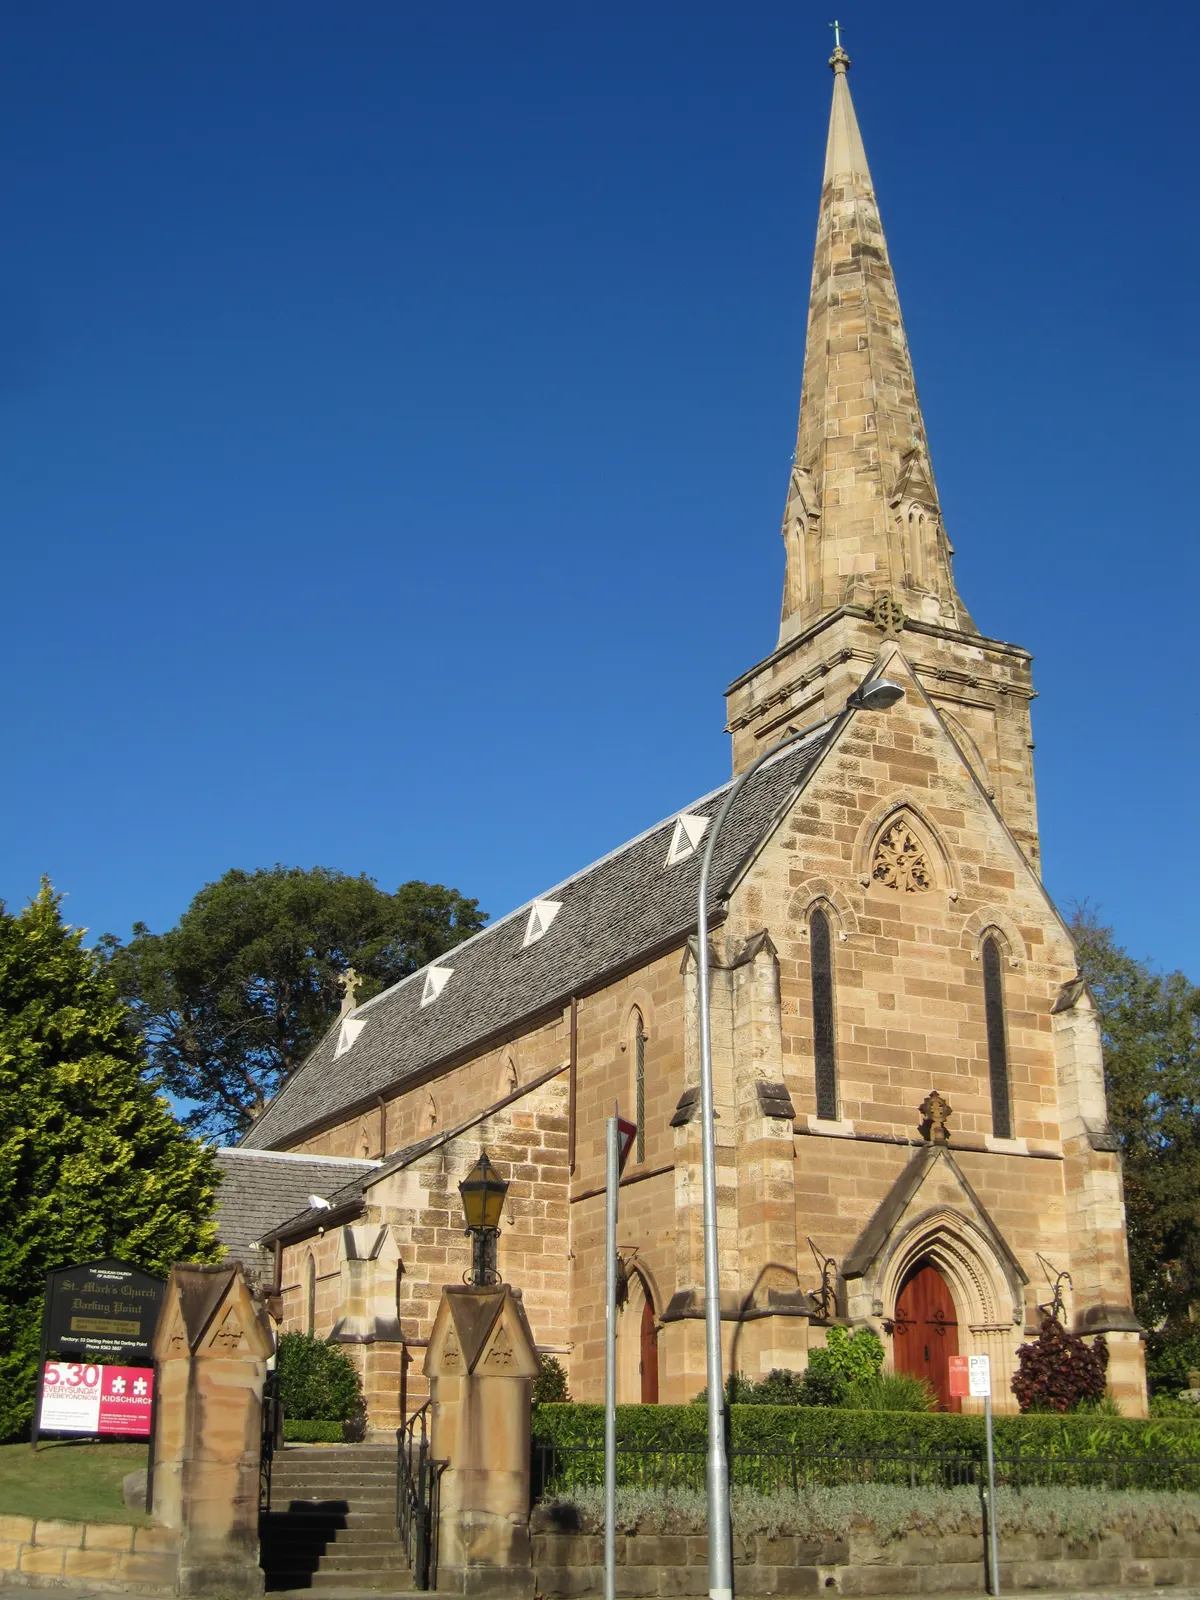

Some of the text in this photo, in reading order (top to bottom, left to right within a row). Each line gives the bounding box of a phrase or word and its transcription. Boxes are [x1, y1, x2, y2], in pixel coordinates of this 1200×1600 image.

[81, 1281, 118, 1295] Mark's
[121, 1285, 156, 1300] Church
[71, 1298, 142, 1314] Darling Point
[44, 1362, 100, 1387] 5.30
[101, 1395, 152, 1405] KIDSCHURCH
